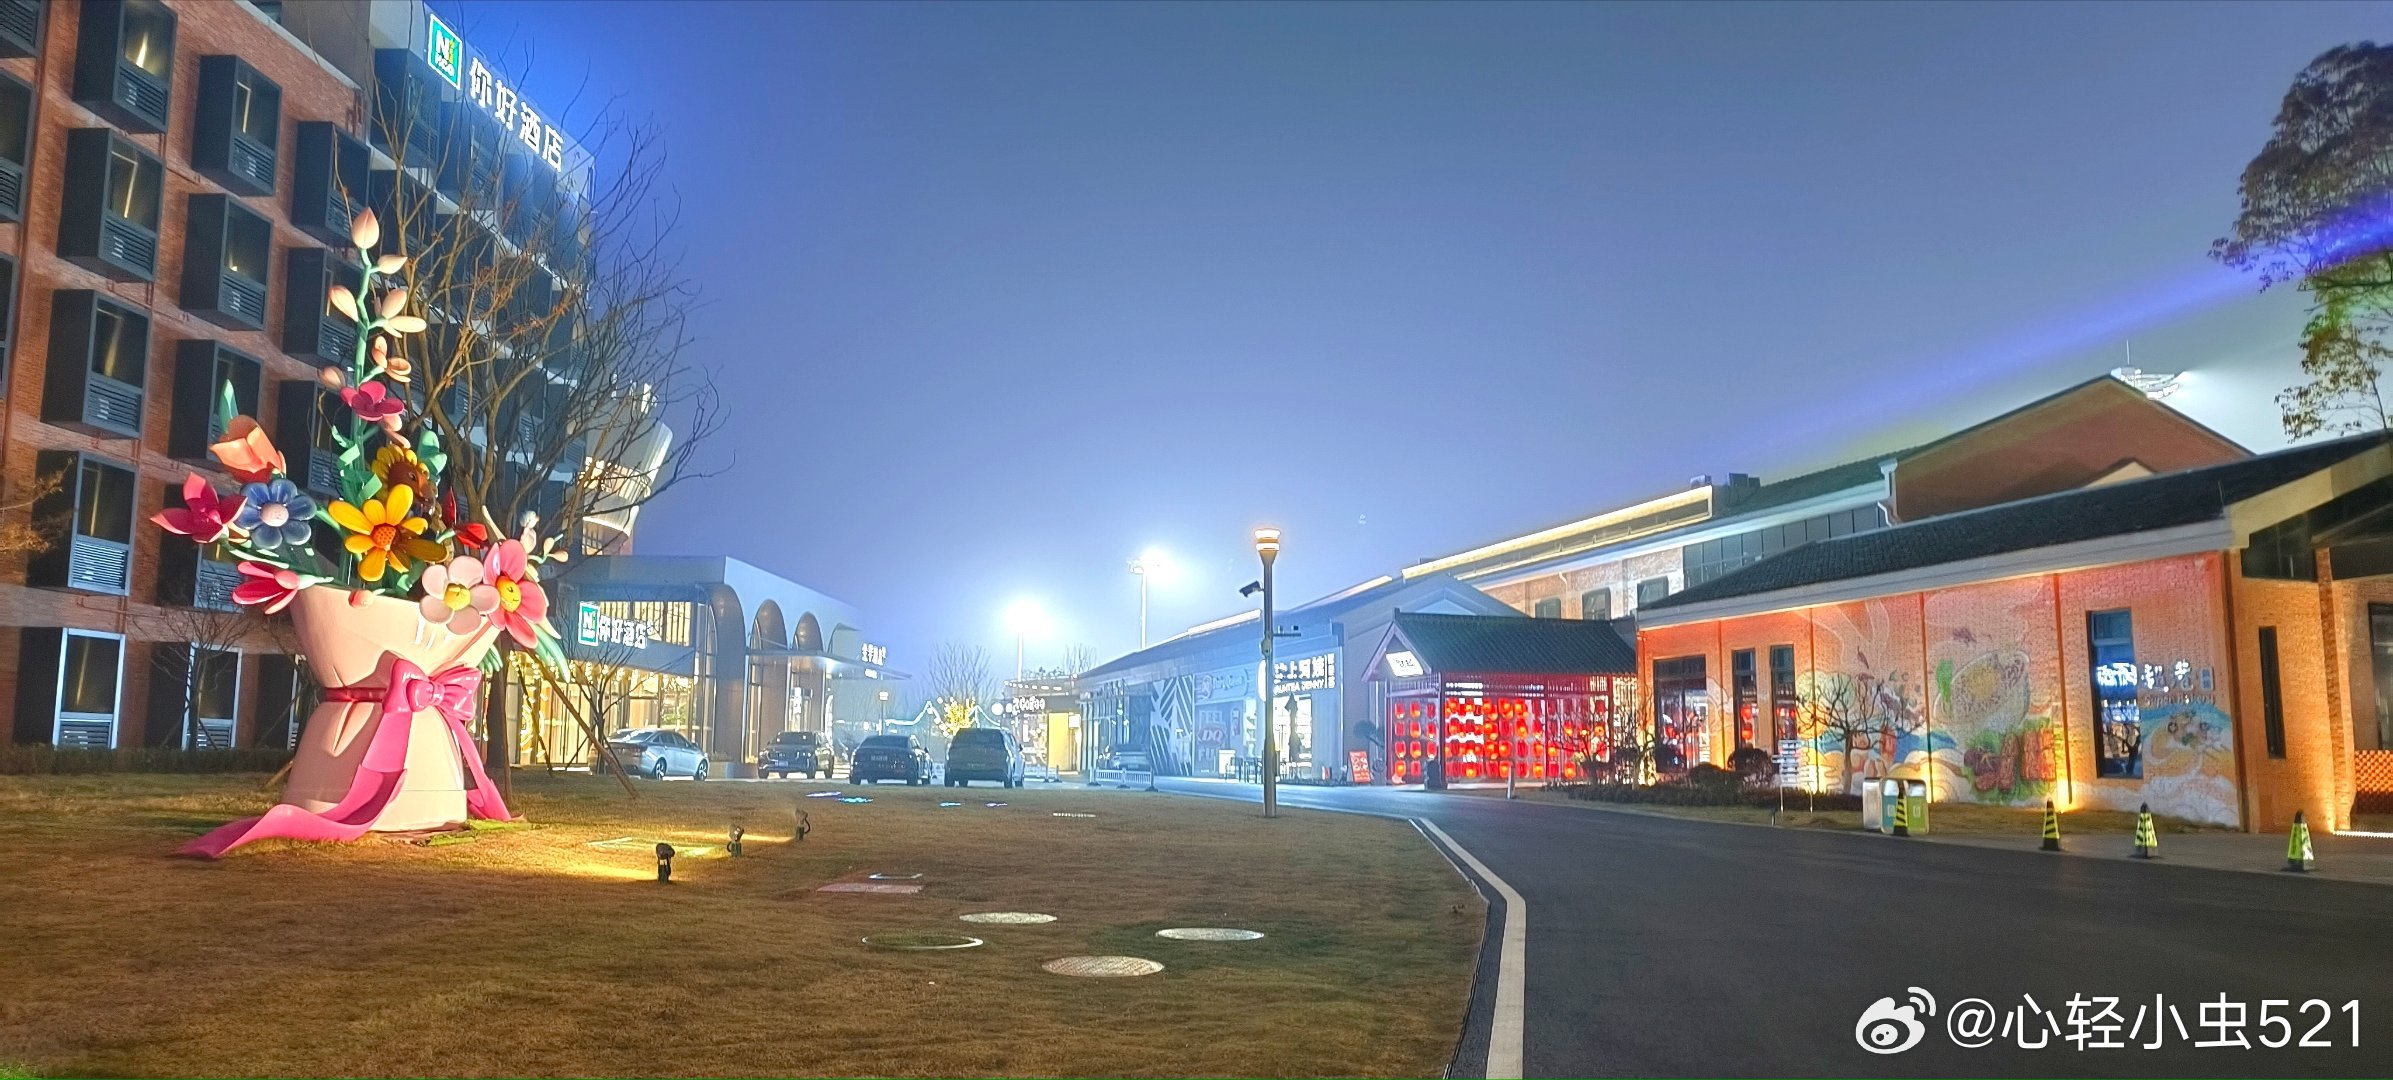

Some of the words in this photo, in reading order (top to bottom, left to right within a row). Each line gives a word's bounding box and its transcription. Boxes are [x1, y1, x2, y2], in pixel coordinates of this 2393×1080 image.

[469, 57, 564, 172] 你好酒店
[599, 615, 648, 650] 你好酒店
